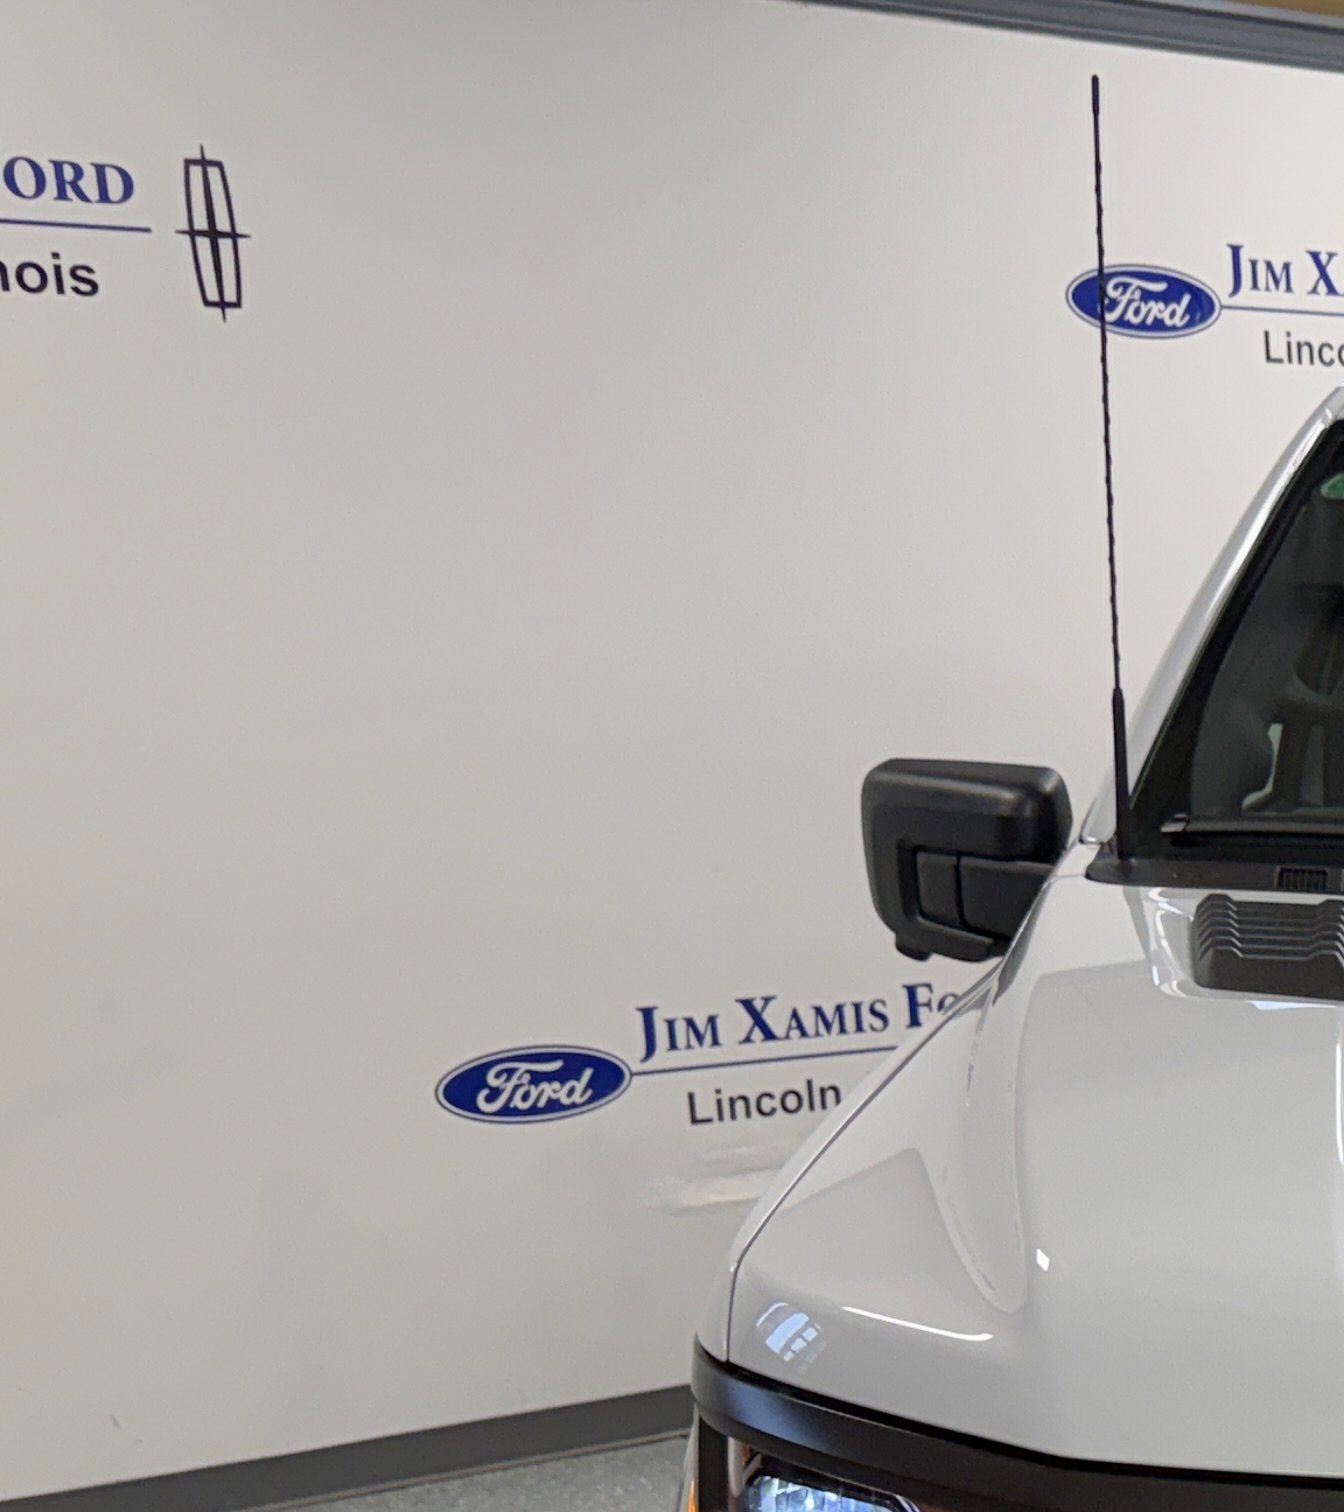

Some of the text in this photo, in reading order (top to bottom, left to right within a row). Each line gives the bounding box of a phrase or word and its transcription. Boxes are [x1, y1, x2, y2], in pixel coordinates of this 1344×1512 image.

[2, 156, 135, 205] ORD
[1226, 243, 1295, 297] JIM
[1097, 276, 1192, 327] Ford
[636, 1006, 722, 1063] JIM
[734, 995, 890, 1045] XAMIS
[476, 1060, 595, 1112] Ford
